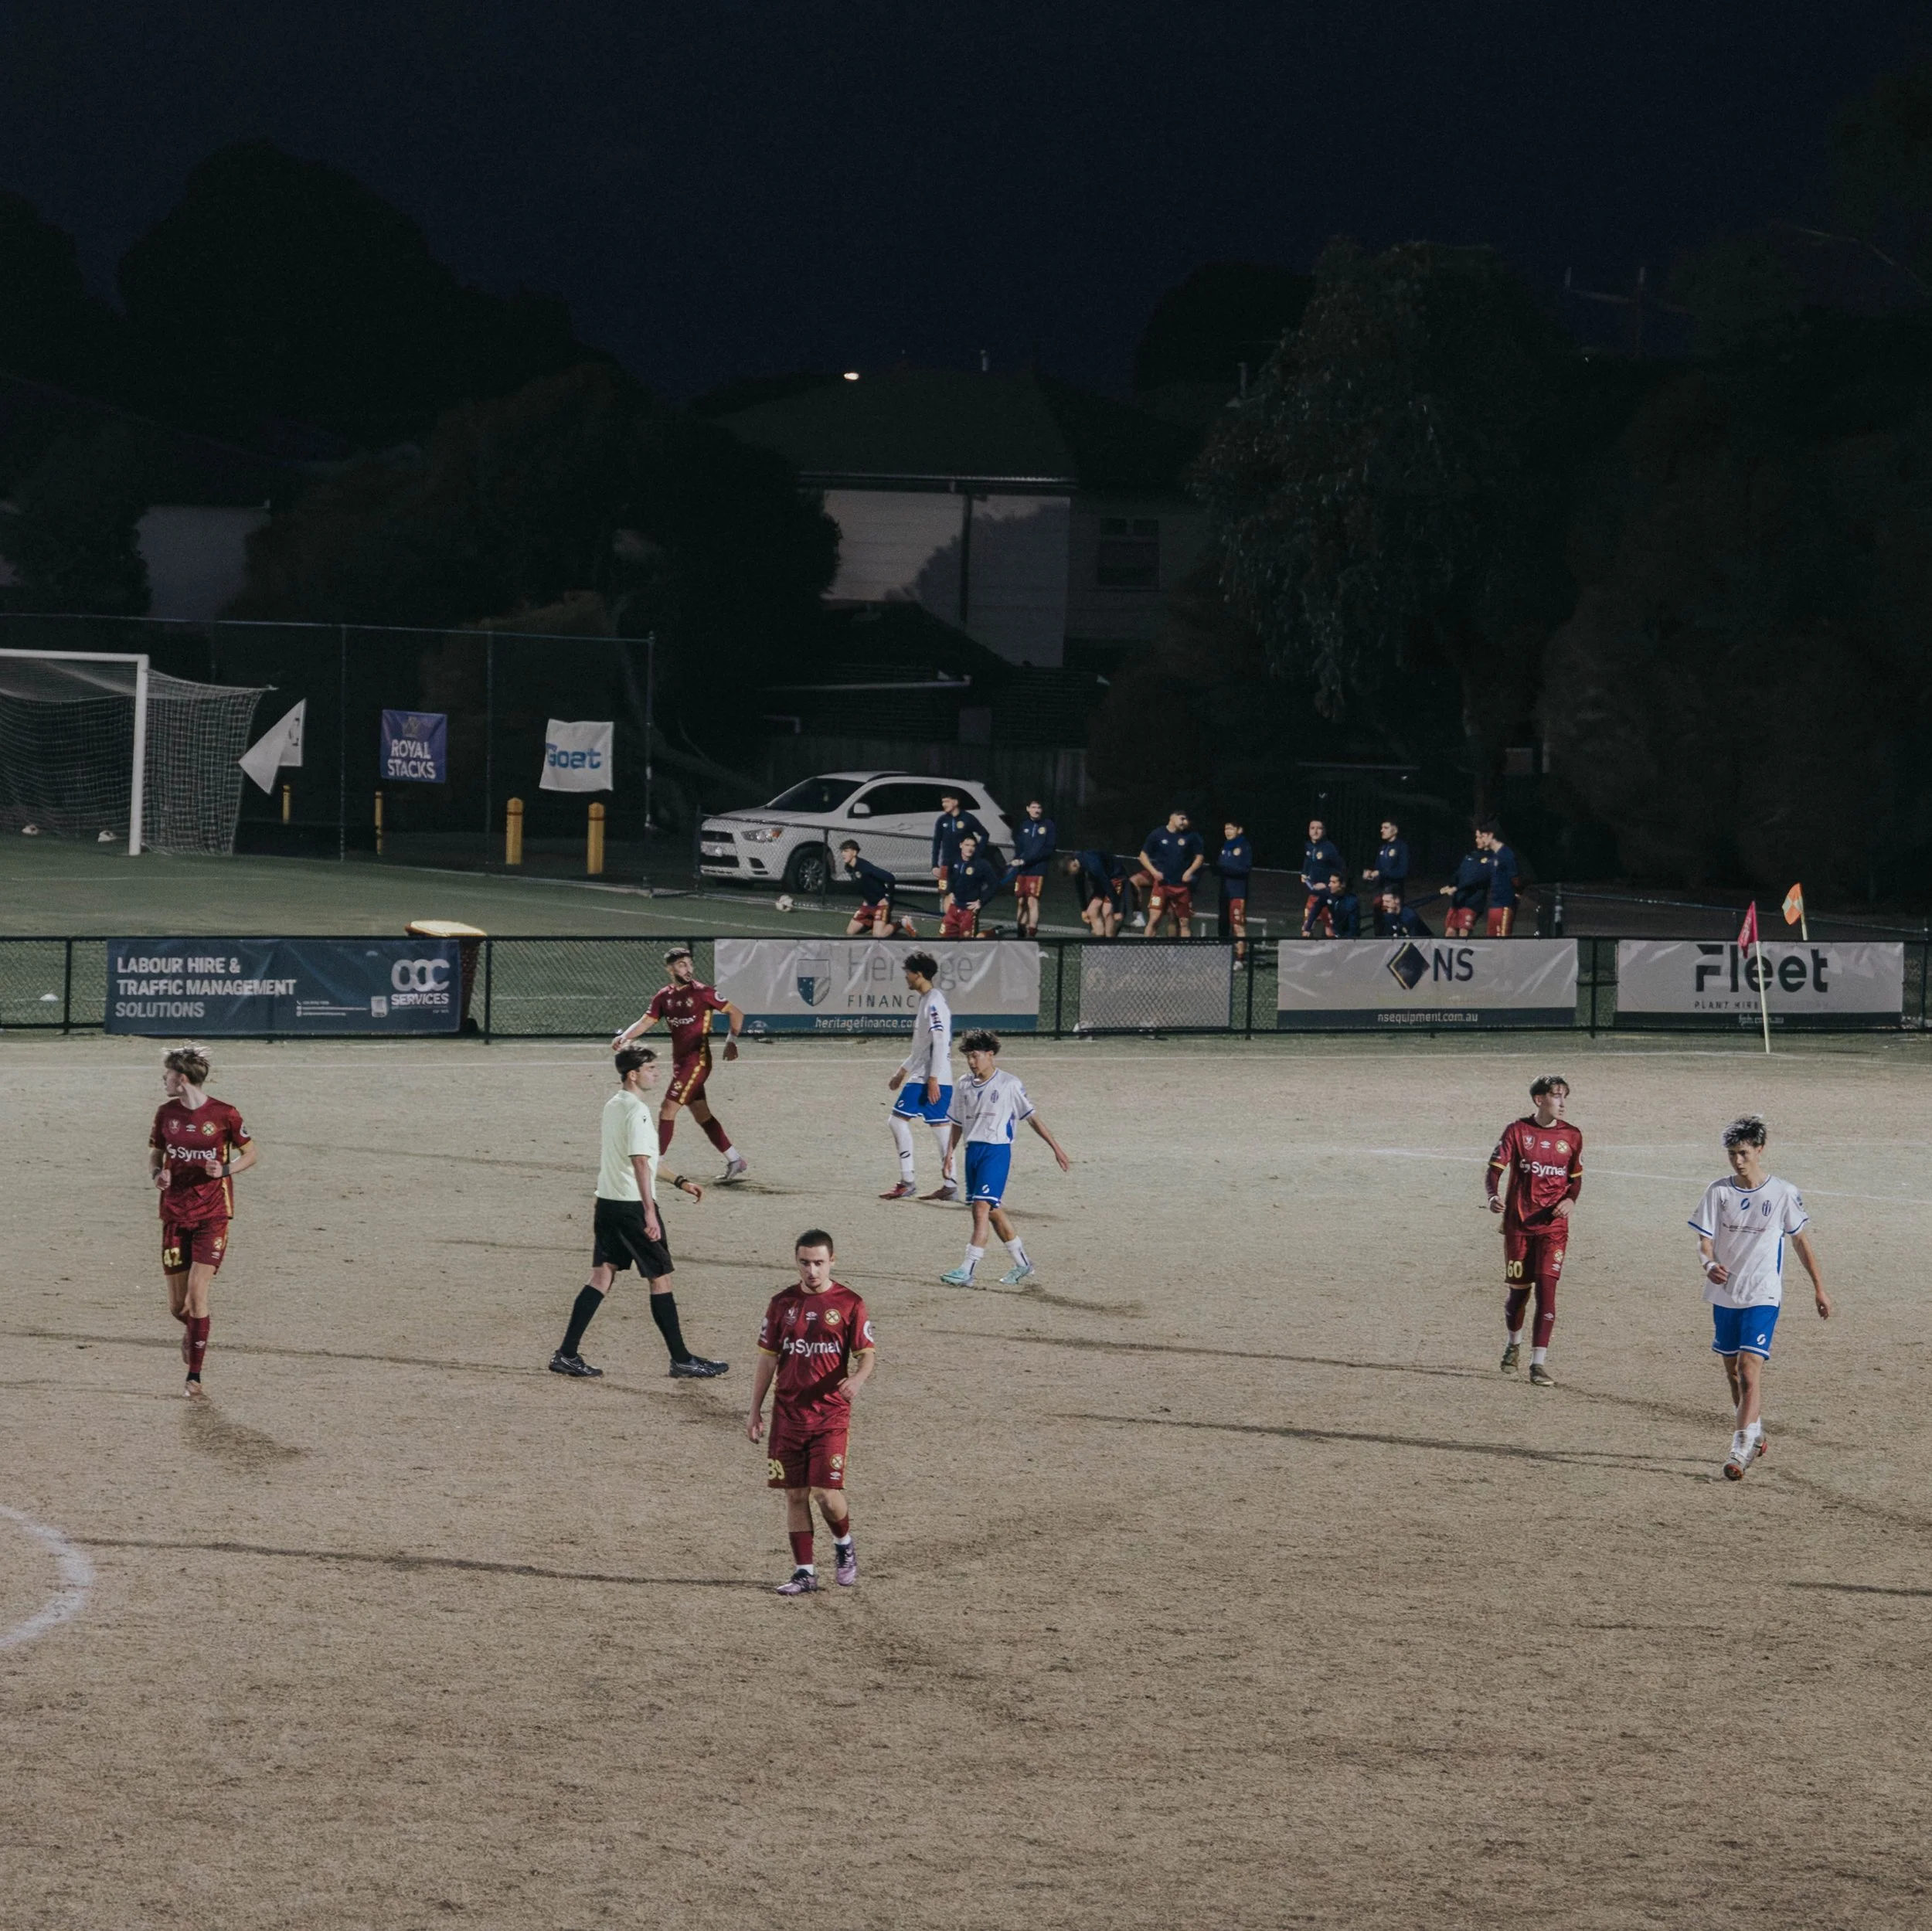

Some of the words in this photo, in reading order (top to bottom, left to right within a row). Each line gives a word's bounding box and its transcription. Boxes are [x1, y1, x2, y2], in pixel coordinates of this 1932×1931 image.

[390, 739, 431, 760] ROYAL
[387, 759, 437, 780] STACKS
[117, 957, 184, 974] LABOUR
[186, 957, 226, 974] HIRE
[228, 957, 242, 974] &
[1433, 947, 1475, 982] NS
[1696, 943, 1828, 994] Fleet
[116, 978, 184, 996] TRAFFIC
[185, 978, 298, 997] MANAGEMENT
[390, 993, 450, 1006] SERVICES
[116, 1001, 206, 1018] SOLUTIONS
[177, 1146, 216, 1162] Symal
[1507, 1260, 1523, 1279] 60
[795, 1338, 842, 1358] Symal
